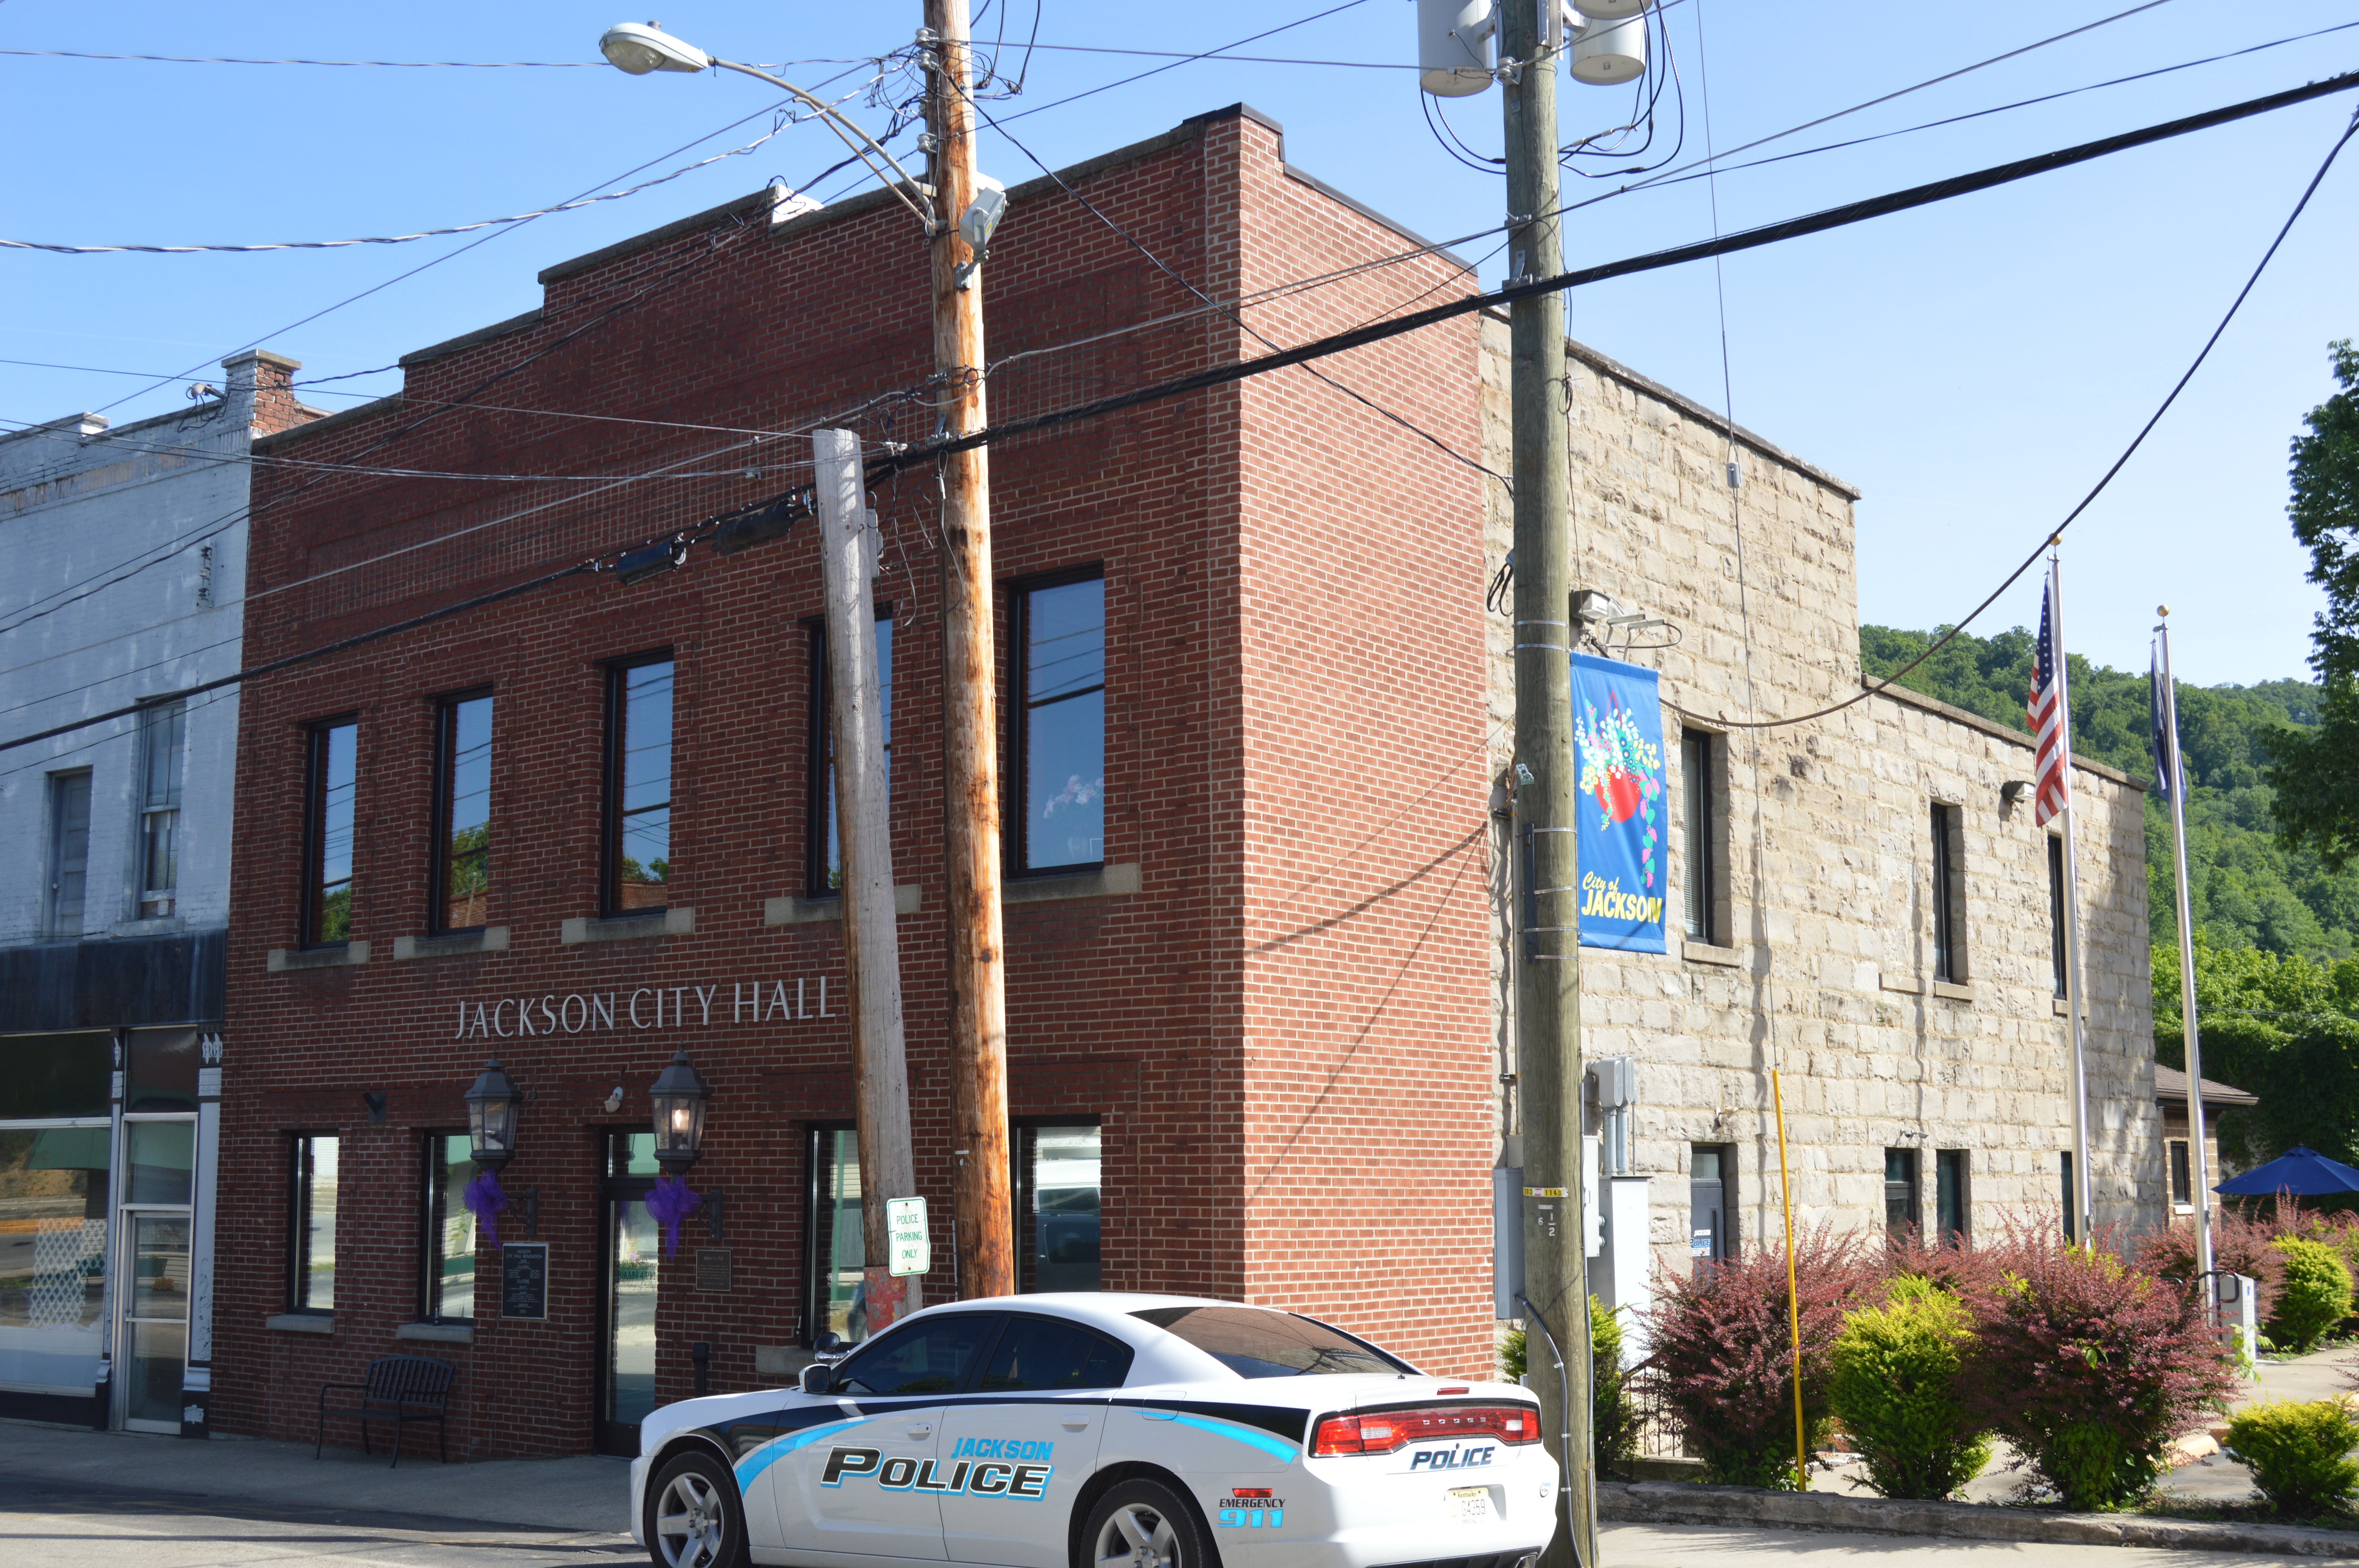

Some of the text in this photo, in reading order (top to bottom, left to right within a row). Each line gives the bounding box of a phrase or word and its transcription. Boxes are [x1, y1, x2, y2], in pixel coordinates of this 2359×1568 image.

[1582, 871, 1619, 896] City of
[1581, 889, 1662, 924] JACKSON
[455, 975, 836, 1040] JACKSON CITY HALL
[896, 1214, 919, 1225] POLICE
[1538, 1217, 1543, 1226] 6
[896, 1231, 923, 1242] PARKING
[902, 1249, 918, 1259] ONLY
[1422, 1417, 1487, 1425] DODGE
[951, 1438, 1054, 1461] JACKSON
[1409, 1446, 1496, 1470] POLICE
[820, 1445, 1055, 1501] POLICE
[1219, 1499, 1286, 1507] EMERGENCY
[1461, 1499, 1486, 1516] G4359
[1218, 1509, 1283, 1528] 911
